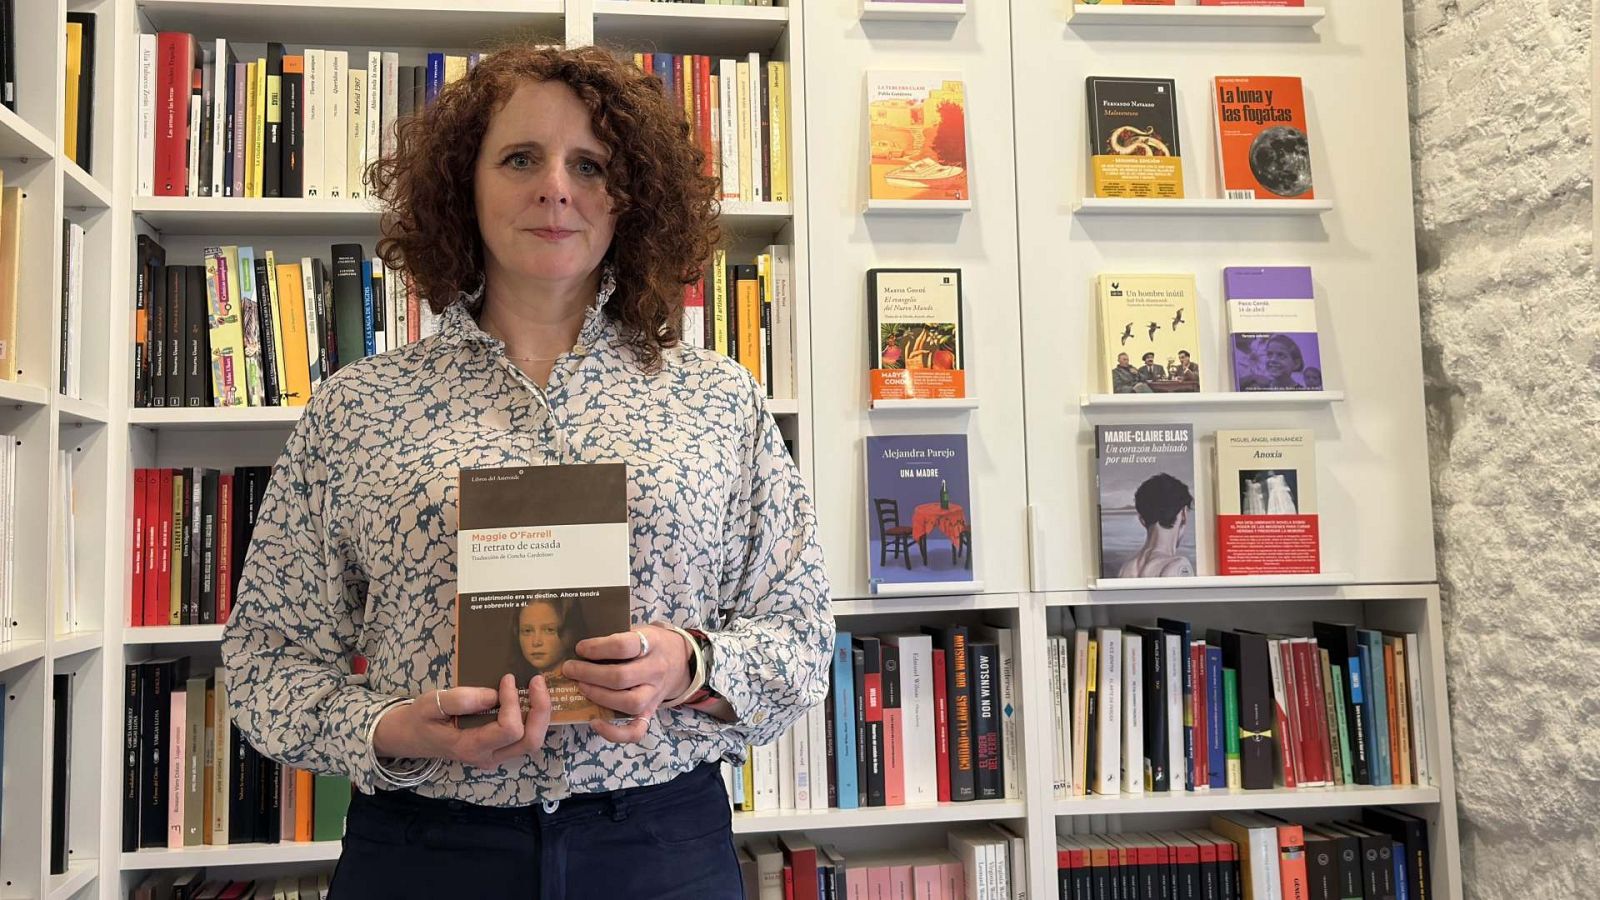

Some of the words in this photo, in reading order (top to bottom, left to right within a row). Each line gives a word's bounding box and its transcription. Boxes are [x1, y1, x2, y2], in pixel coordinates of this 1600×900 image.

[1220, 87, 1234, 103] La
[1236, 87, 1264, 103] luna
[1265, 90, 1273, 106] y
[1222, 105, 1241, 122] las
[1242, 105, 1292, 125] fogatas
[716, 285, 722, 293] de
[365, 306, 371, 314] DE
[1104, 430, 1164, 443] MARIE-CLAIRE
[1165, 430, 1188, 441] BLAIS
[882, 449, 925, 459] Alejandra
[927, 448, 955, 458] Parejo
[1105, 445, 1118, 453] Un
[1119, 444, 1150, 454] corazón
[1151, 443, 1188, 453] habitado
[1253, 450, 1283, 459] Anoxia
[1105, 456, 1119, 466] por
[1121, 455, 1134, 463] mil
[1136, 456, 1156, 464] voces
[900, 469, 914, 478] UNA
[916, 468, 939, 477] MADRE
[472, 532, 508, 542] Maggie
[510, 529, 553, 540] O'Farrell
[472, 543, 482, 553] El
[484, 543, 515, 552] retrato
[517, 541, 528, 551] de
[530, 540, 561, 550] casada
[472, 553, 500, 561] Traducción
[479, 594, 514, 602] matrimonio
[534, 592, 558, 600] destino.
[560, 591, 578, 599] Ahora
[579, 590, 600, 598] tendrá
[484, 601, 514, 609] sobrevivir
[954, 635, 966, 671] WINSLOW
[957, 672, 966, 688] DON
[979, 655, 990, 697] WINSLOW
[556, 685, 579, 694] novel
[957, 695, 969, 731] LLAMAS
[981, 700, 991, 718] DON
[978, 735, 987, 757] PODER
[987, 732, 997, 755] PERRO
[959, 737, 970, 770] CIUDAD
[979, 759, 987, 768] EL
[988, 757, 998, 771] DEL
